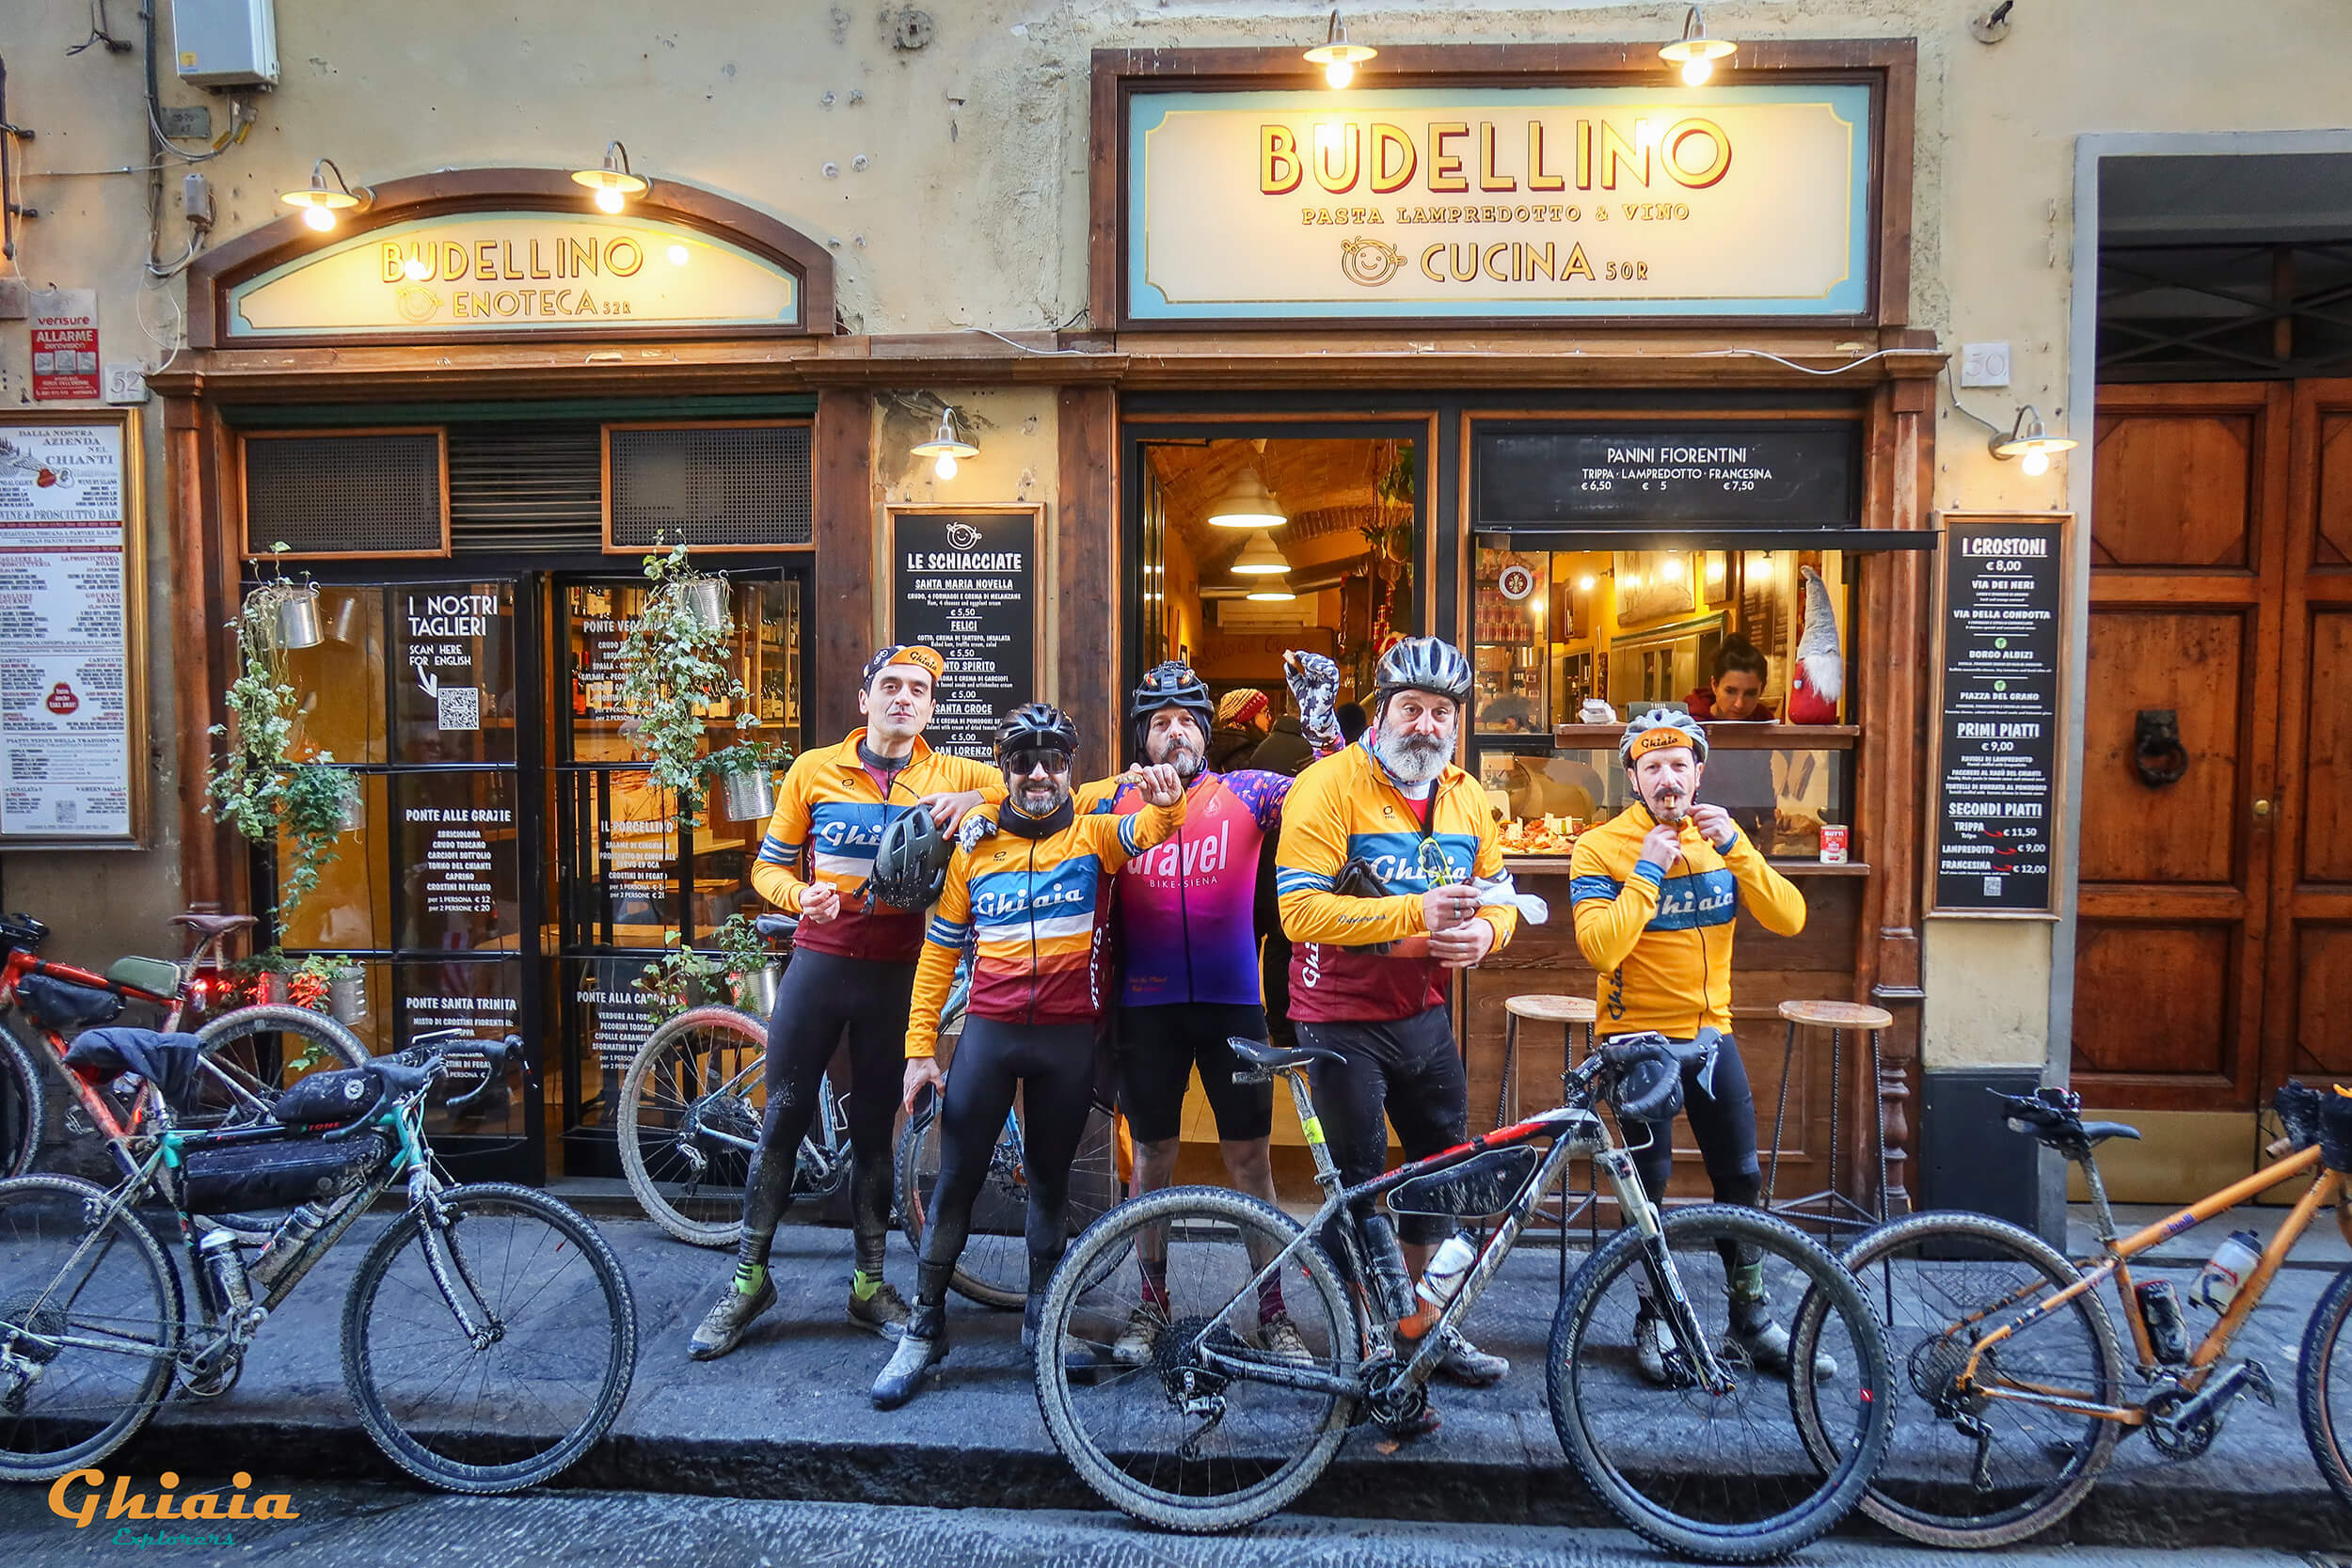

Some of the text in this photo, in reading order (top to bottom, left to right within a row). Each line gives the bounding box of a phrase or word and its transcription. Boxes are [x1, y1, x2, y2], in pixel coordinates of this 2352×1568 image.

[1259, 119, 1732, 196] BUDELLINO
[1302, 202, 1690, 226] PASTA LAMPREDOTTO & VINO
[381, 236, 644, 284] BUDELLINO
[1420, 242, 1649, 283] CUCINA 50R
[453, 289, 631, 318] ENOTECA 52R
[38, 316, 90, 325] verisure
[37, 330, 93, 342] ALLARME
[110, 371, 140, 394] 52
[43, 436, 101, 446] AZIENDA
[46, 455, 114, 465] CHIANTI
[1607, 448, 1747, 464] PANINI FIORENTINI
[1582, 468, 1772, 480] TRIPPA LAMPREDOTTO FRANCESINA
[1590, 482, 1612, 492] 6,50
[1661, 482, 1667, 490] 5
[1732, 482, 1755, 492] 7,50
[34, 509, 96, 520] PROSCIUTTO
[98, 509, 119, 519] BAR
[1963, 538, 2046, 555] I CROSTONI
[907, 552, 1022, 569] LE SCHIACCIATE
[1995, 561, 2022, 572] 8,00
[915, 578, 1013, 589] SANTA MARIA NOVELLA
[1972, 580, 2035, 590] VIA DEI NERI
[408, 595, 499, 615] I NOSTRI
[958, 609, 976, 617] 5,50
[1953, 610, 2051, 620] VIA DELLA CONDOTTA
[408, 617, 486, 636] TAGLIERI
[583, 621, 614, 633] PONTE
[950, 621, 977, 631] FELICI
[409, 644, 463, 655] SCAN HERE
[957, 649, 975, 657] 5,50
[2002, 651, 2033, 659] ALBIZI
[409, 656, 471, 666] FOR ENGLISH
[910, 651, 937, 671] Ghiaia
[944, 661, 995, 671] NTO SPIRITO
[958, 690, 977, 700] 5,00
[2010, 692, 2040, 701] GRANO
[934, 704, 993, 714] SANTA CROCE
[1957, 722, 2040, 737] PRIMI PIATTI
[958, 733, 976, 741] 5,00
[1641, 736, 1678, 748] Ghiaia
[934, 746, 993, 756] SAN LORENZO
[1991, 741, 2014, 752] 9,00
[1948, 802, 2042, 816] SECONDI PIATTI
[405, 809, 440, 822] PONTE
[442, 809, 469, 822] ALLE
[600, 820, 674, 833] IL PORCELLINO
[1954, 822, 1984, 832] TRIPPA
[2011, 828, 2037, 838] 11,50
[820, 821, 882, 847] Ghi
[1942, 845, 1994, 854] LAMPREDOTTO
[2026, 844, 2046, 853] 9,00
[1941, 860, 1992, 870] FRANCESINA
[2021, 865, 2046, 874] 12,00
[445, 872, 475, 880] CAPRINO
[1150, 876, 1217, 889] BIKE SIENA
[977, 883, 1084, 917] Ghiaia
[1651, 885, 1734, 919] hiaia
[1302, 941, 1321, 988] Ghi
[1608, 962, 1626, 1021] Ghia
[405, 997, 517, 1010] PONTE SANTA TRINITA
[577, 991, 607, 1004] PONTE
[609, 992, 632, 1005] ALLA
[619, 1033, 649, 1041] CARAMELL
